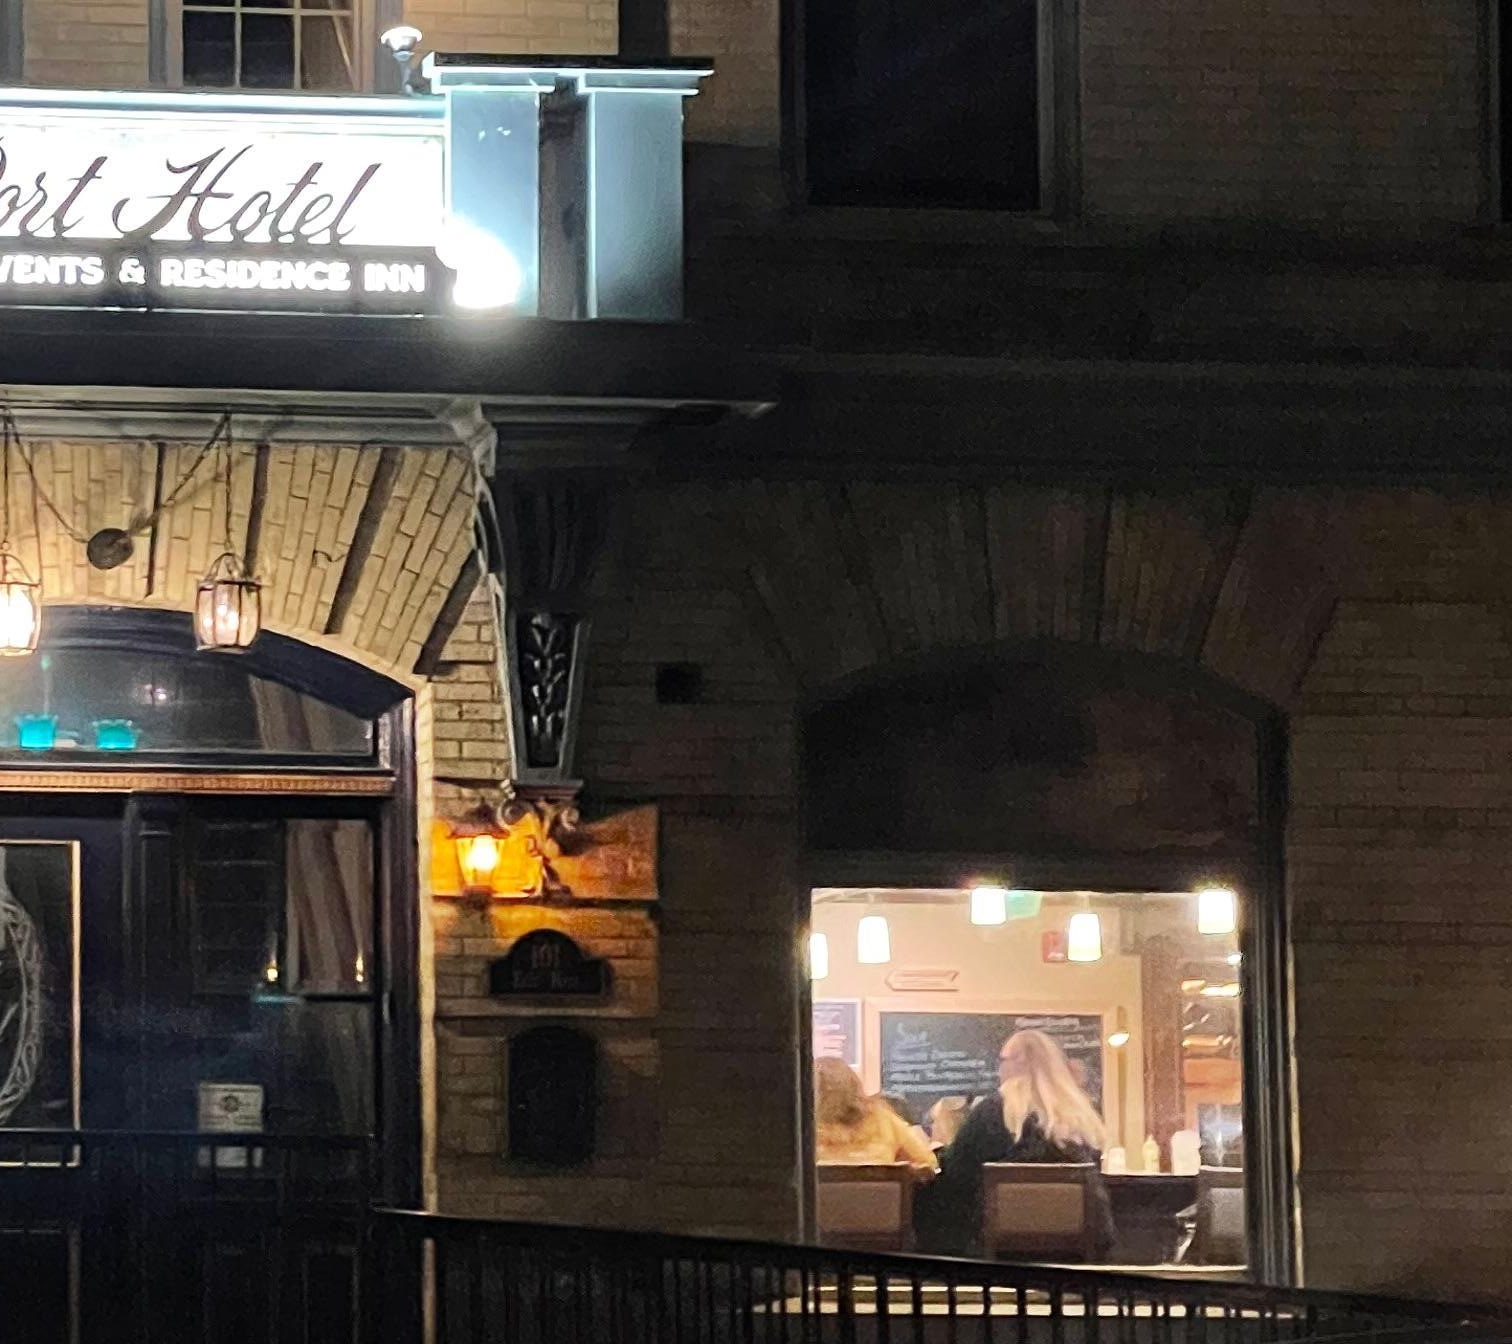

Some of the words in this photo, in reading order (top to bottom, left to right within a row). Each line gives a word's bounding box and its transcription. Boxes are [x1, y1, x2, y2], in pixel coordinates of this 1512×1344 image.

[112, 144, 382, 242] Hotel
[119, 256, 146, 285] &
[160, 258, 351, 291] RESIDENCE
[363, 262, 425, 292] INN
